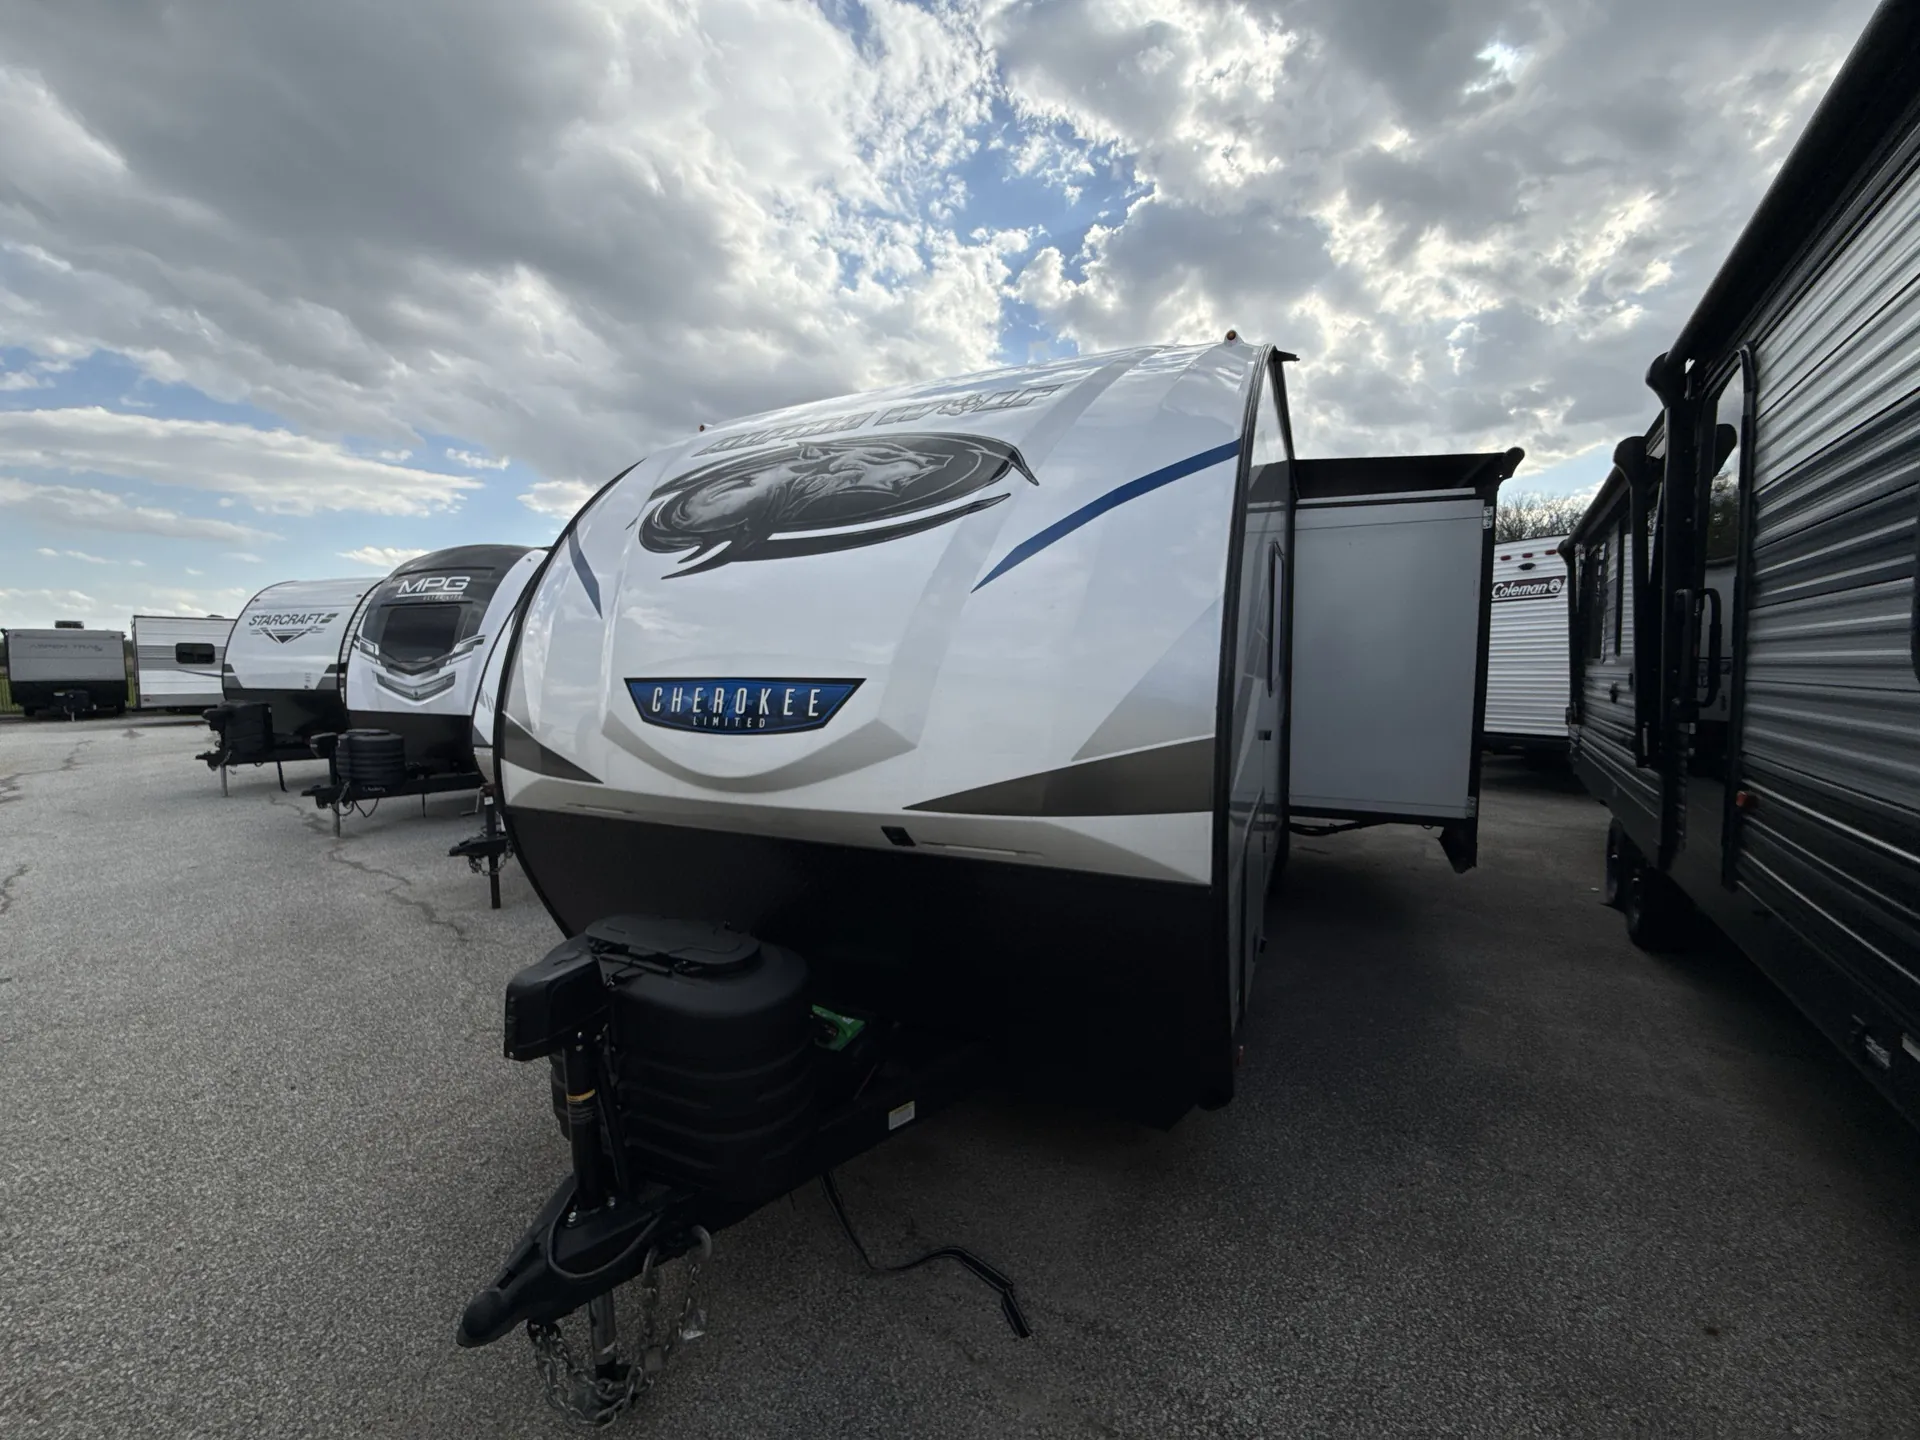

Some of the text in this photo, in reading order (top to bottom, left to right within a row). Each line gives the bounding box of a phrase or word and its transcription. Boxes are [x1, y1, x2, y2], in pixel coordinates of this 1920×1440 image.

[397, 576, 471, 594] MPG
[1491, 582, 1548, 599] Coleman
[248, 613, 325, 626] STARCRAFT
[652, 687, 821, 717] CHEROKEE
[693, 717, 766, 729] LIMITED
